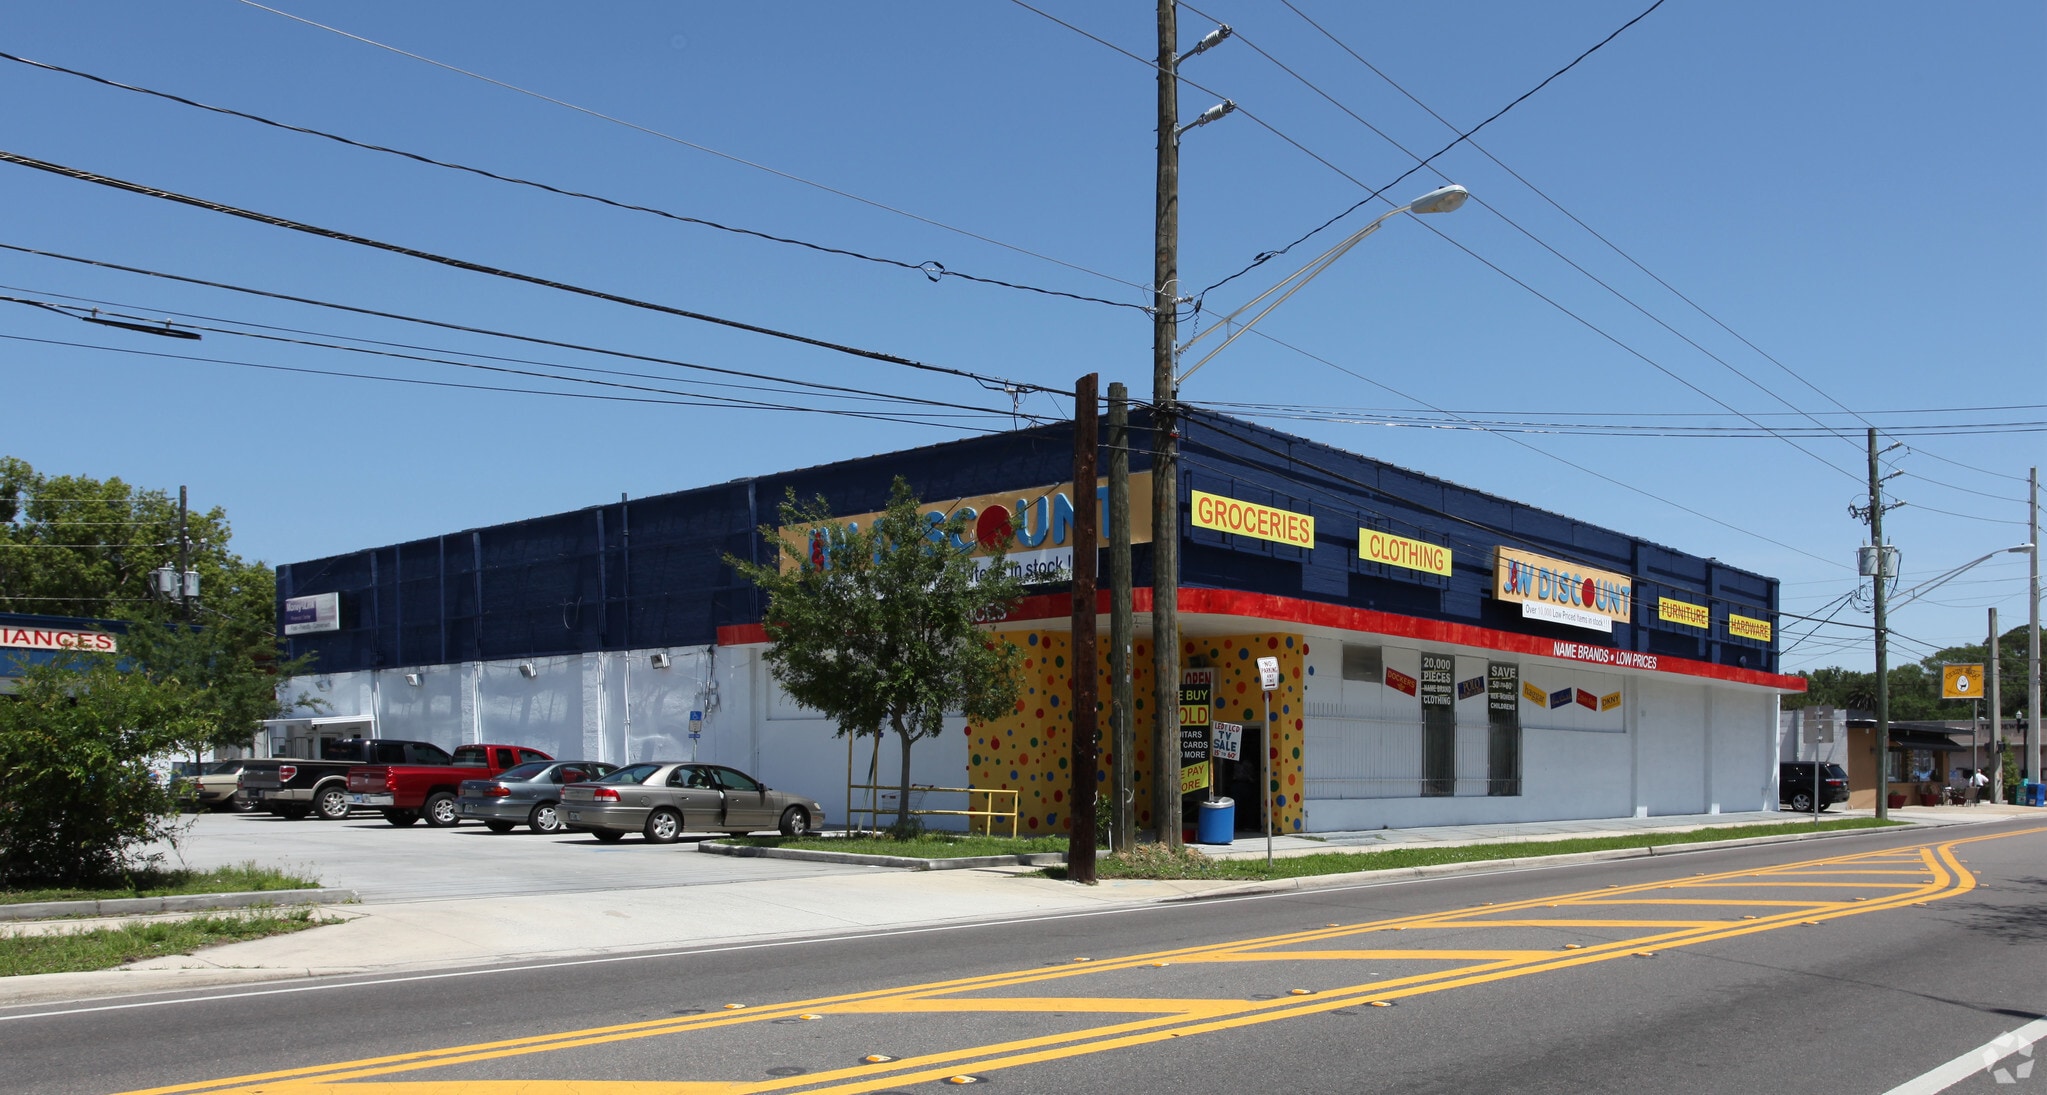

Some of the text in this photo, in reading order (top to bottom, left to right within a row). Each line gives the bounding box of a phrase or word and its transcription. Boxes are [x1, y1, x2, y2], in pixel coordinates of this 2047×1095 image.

[1198, 496, 1310, 543] GROCERIES
[1369, 534, 1444, 571] CLOTHING
[1026, 555, 1063, 576] stock
[1537, 566, 1631, 616] DISCOUNT
[1525, 602, 1537, 614] Over
[1552, 609, 1562, 618] Low
[1562, 610, 1576, 622] Priced
[1576, 613, 1588, 624] Items
[1592, 616, 1603, 627] stock
[1661, 601, 1707, 626] FURNITURE
[1730, 617, 1769, 640] HARDWARE
[3, 627, 112, 650] IANCES
[1553, 641, 1657, 669] NAME BRANDS LOW PRICES
[1423, 657, 1451, 671] 20,000
[1423, 671, 1451, 683] PIECES
[1491, 665, 1516, 678] SAVE
[1388, 670, 1415, 689] DOCKERS
[1186, 690, 1208, 701] BUY
[1423, 684, 1437, 692] NAME
[1437, 685, 1452, 693] BRAND
[1423, 695, 1451, 705] CLOTHING
[1490, 702, 1515, 711] CHILDRENS
[1602, 695, 1620, 707] DKNY
[1179, 706, 1208, 725] OLD
[1180, 730, 1202, 738] ITARS
[1183, 741, 1208, 749] CARDS
[1213, 739, 1237, 752] SALE
[1184, 750, 1205, 759] MORE
[1187, 764, 1205, 777] PAY
[1181, 778, 1200, 792] ORE
